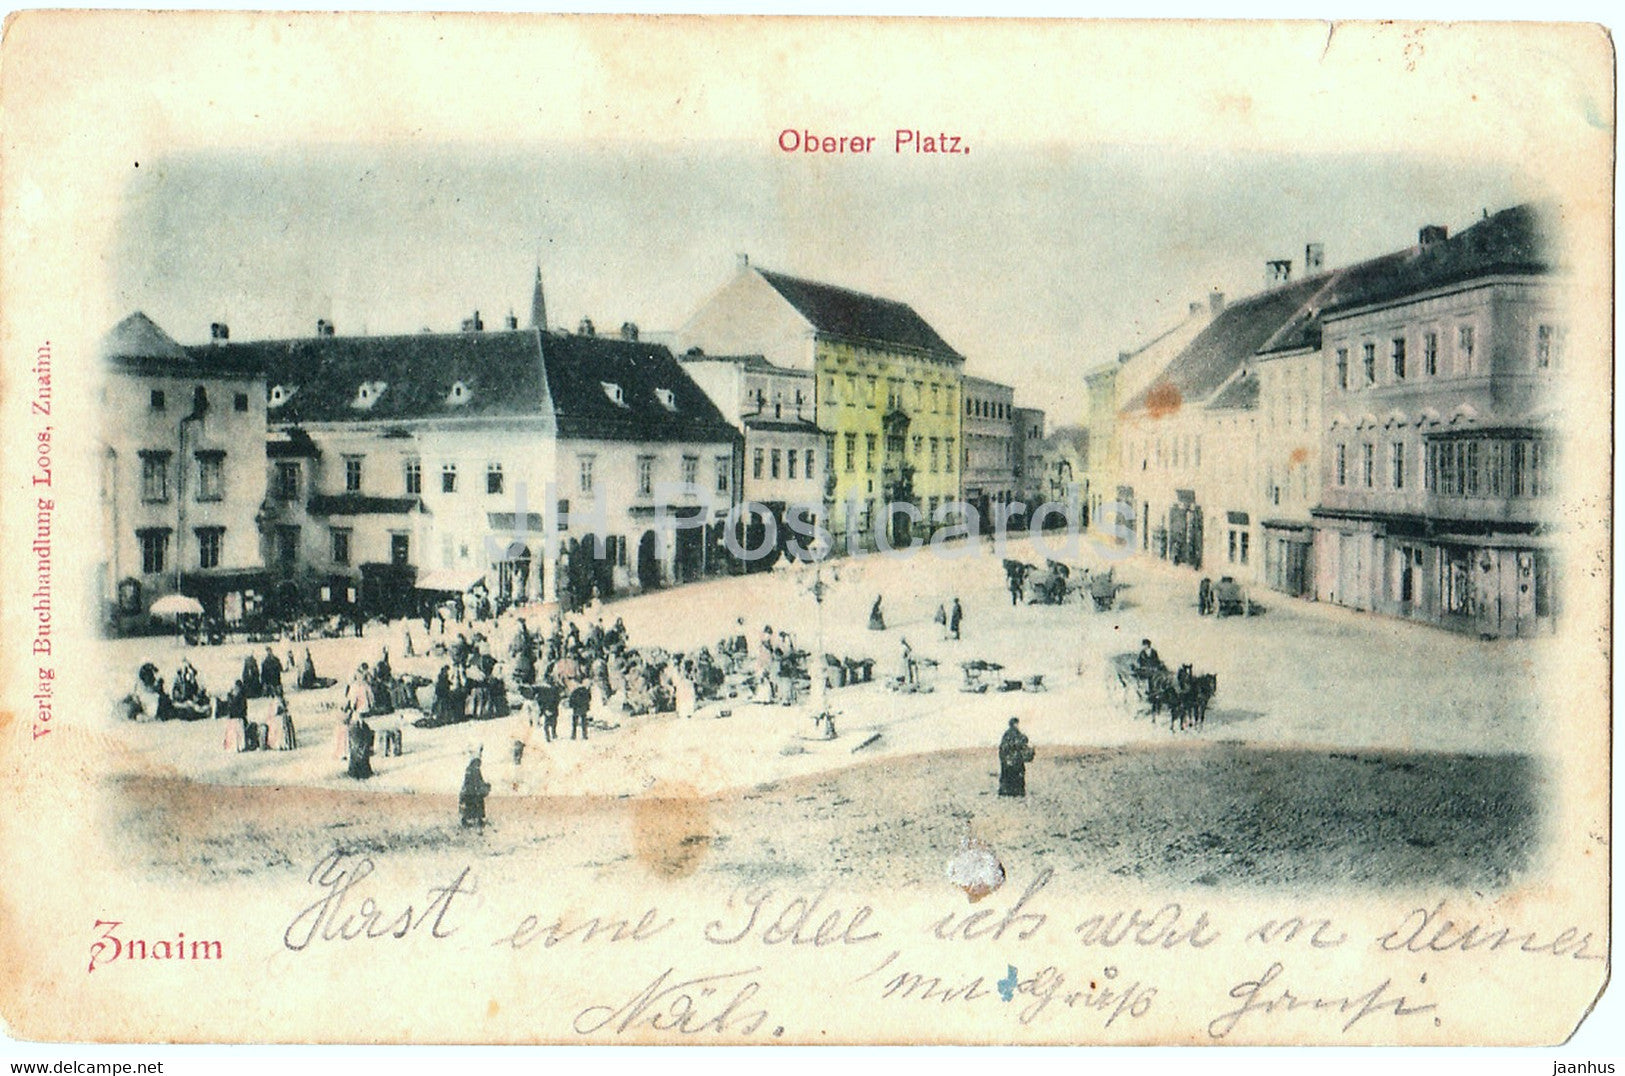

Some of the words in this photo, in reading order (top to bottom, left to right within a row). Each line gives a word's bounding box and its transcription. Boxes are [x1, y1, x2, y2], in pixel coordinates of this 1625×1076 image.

[779, 129, 876, 153] Oberer
[895, 129, 970, 154] Platz.
[32, 340, 51, 415] Znaim.
[32, 426, 53, 487] Loos,
[33, 498, 54, 655] Buchhandlung
[33, 667, 54, 740] Verlag
[88, 919, 222, 973] Znaim
